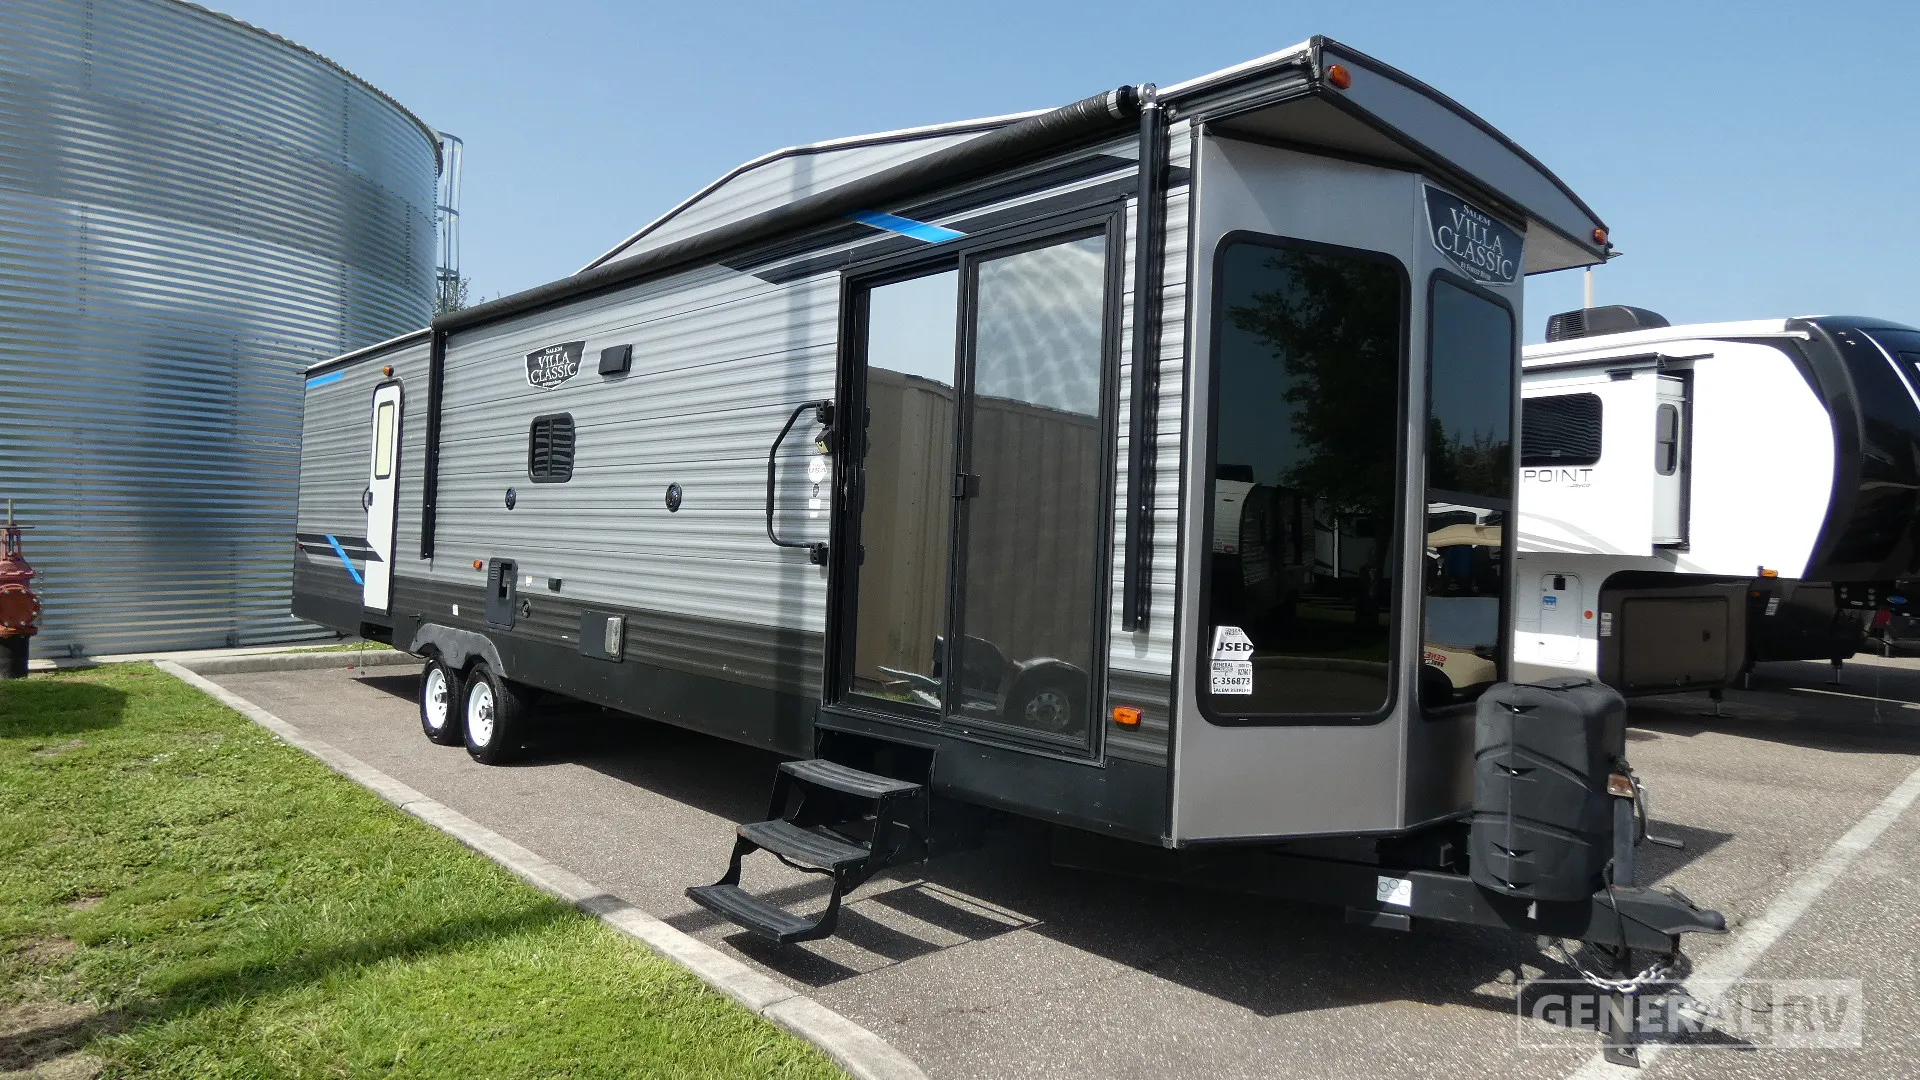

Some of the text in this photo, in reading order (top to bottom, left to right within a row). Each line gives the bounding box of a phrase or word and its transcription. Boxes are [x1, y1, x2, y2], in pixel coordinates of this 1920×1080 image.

[1463, 204, 1490, 226] SALEM
[1450, 207, 1504, 256] VILLA
[1438, 225, 1513, 280] CLASSIC
[538, 351, 570, 369] VILLA
[530, 362, 576, 383] CLASSIC
[1523, 468, 1593, 482] POINT
[1212, 677, 1251, 685] C-356873
